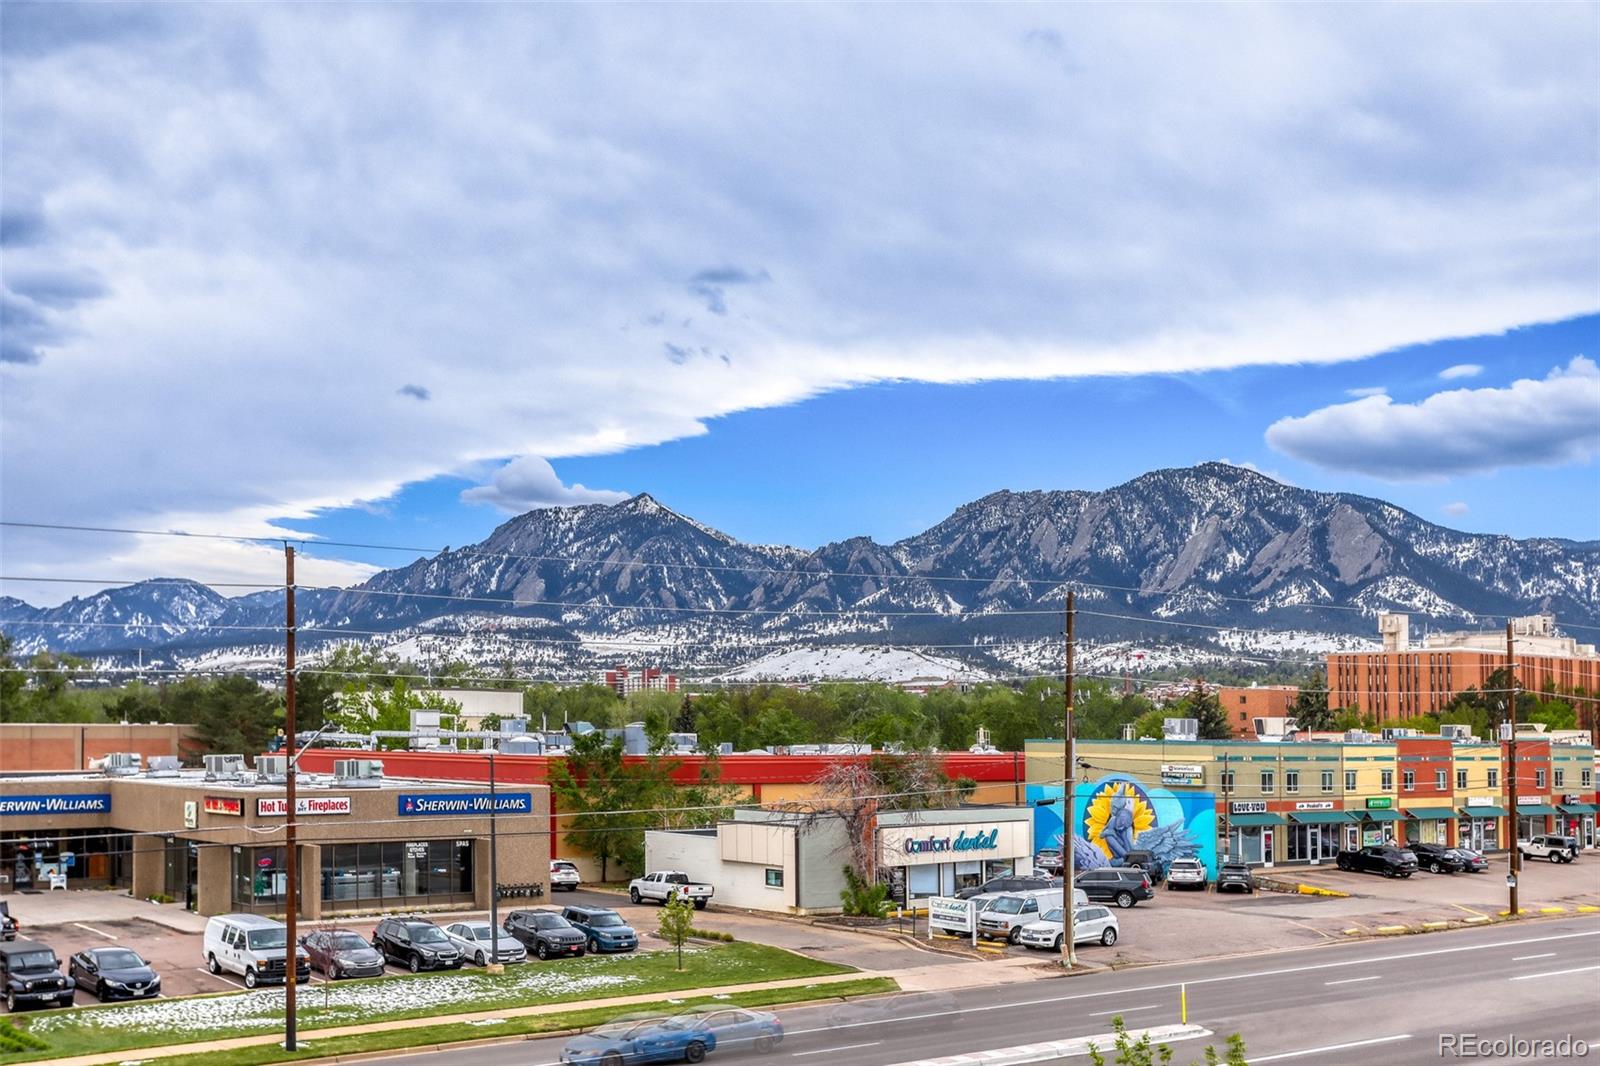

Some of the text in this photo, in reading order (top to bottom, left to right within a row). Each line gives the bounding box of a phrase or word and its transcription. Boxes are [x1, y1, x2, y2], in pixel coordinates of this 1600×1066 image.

[260, 801, 275, 813] Hot
[308, 800, 348, 813] Fireplaces
[415, 797, 526, 812] SHERWIN-WILLIAMS
[455, 840, 470, 848] SPAS
[905, 828, 998, 854] Comfort dental
